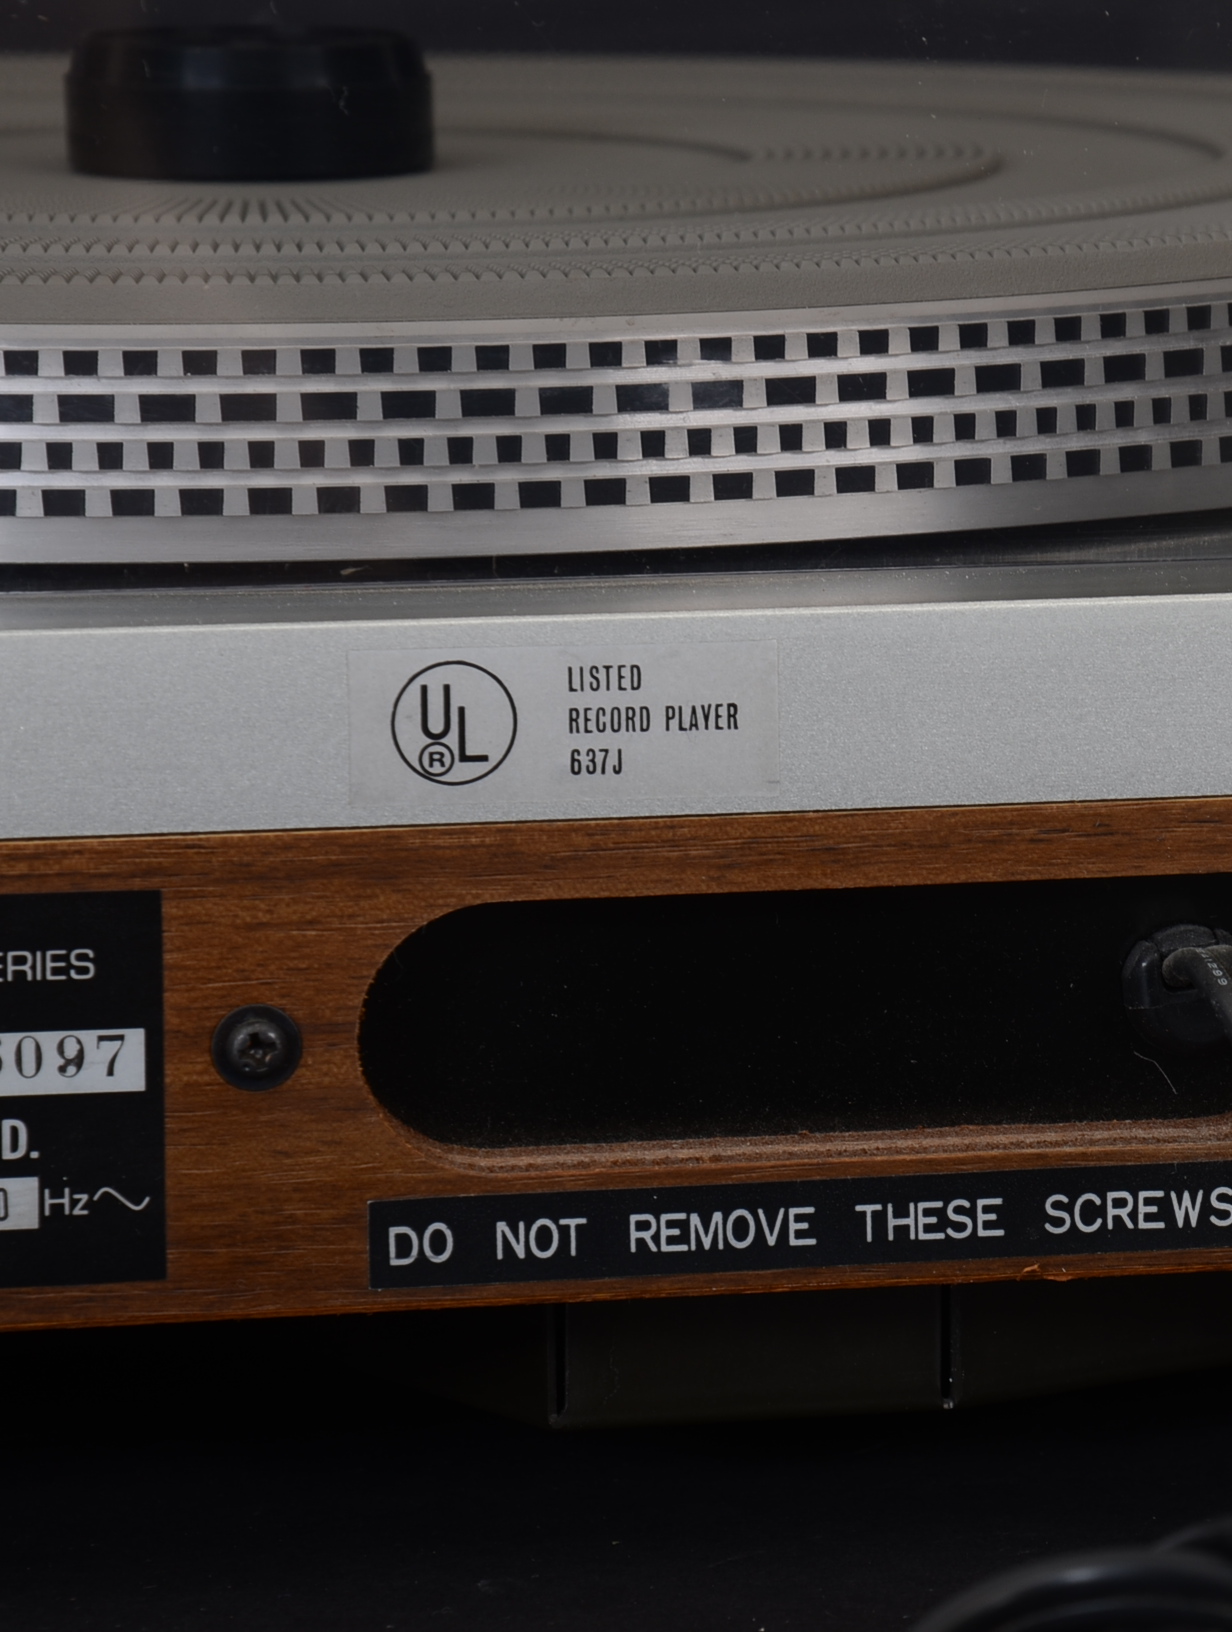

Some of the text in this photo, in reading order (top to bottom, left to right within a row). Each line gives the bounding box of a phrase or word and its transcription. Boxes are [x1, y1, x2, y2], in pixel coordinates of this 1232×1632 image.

[568, 665, 641, 692] LISTED
[569, 703, 738, 734] RECORD PLAYER
[571, 749, 622, 775] 637J
[0, 949, 94, 981] RIES
[0, 1034, 125, 1078] 097
[389, 1223, 453, 1265] DO
[497, 1218, 586, 1259] NOT
[630, 1207, 816, 1252] REMOVE
[855, 1198, 1004, 1242] THESE
